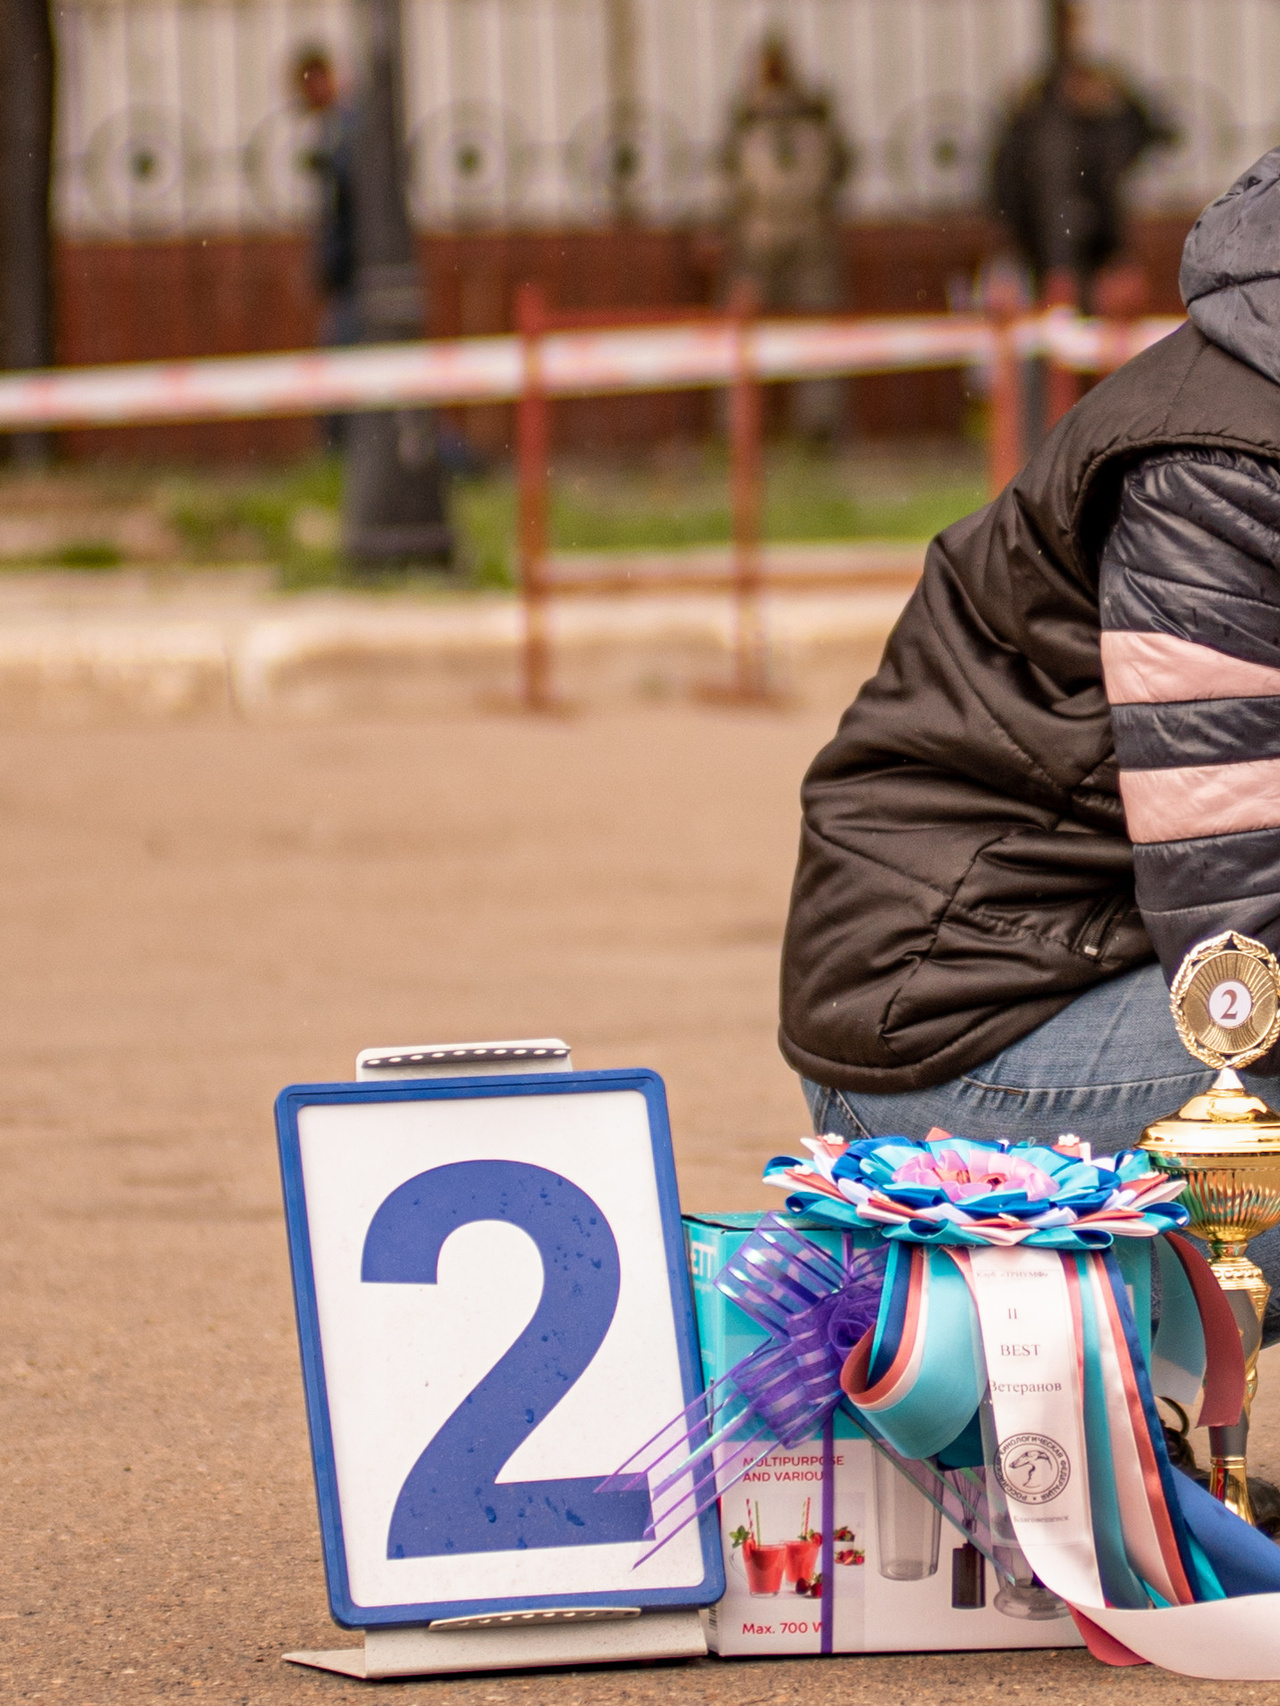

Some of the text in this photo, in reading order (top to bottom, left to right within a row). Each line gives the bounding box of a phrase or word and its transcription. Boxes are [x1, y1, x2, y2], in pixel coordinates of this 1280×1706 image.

[1219, 988, 1239, 1020] 2
[1000, 1344, 1040, 1357] BEST
[360, 1159, 657, 1561] 2
[742, 1471, 825, 1483] AND VARIOU
[742, 1623, 775, 1635] Max.
[779, 1621, 808, 1634] 700
